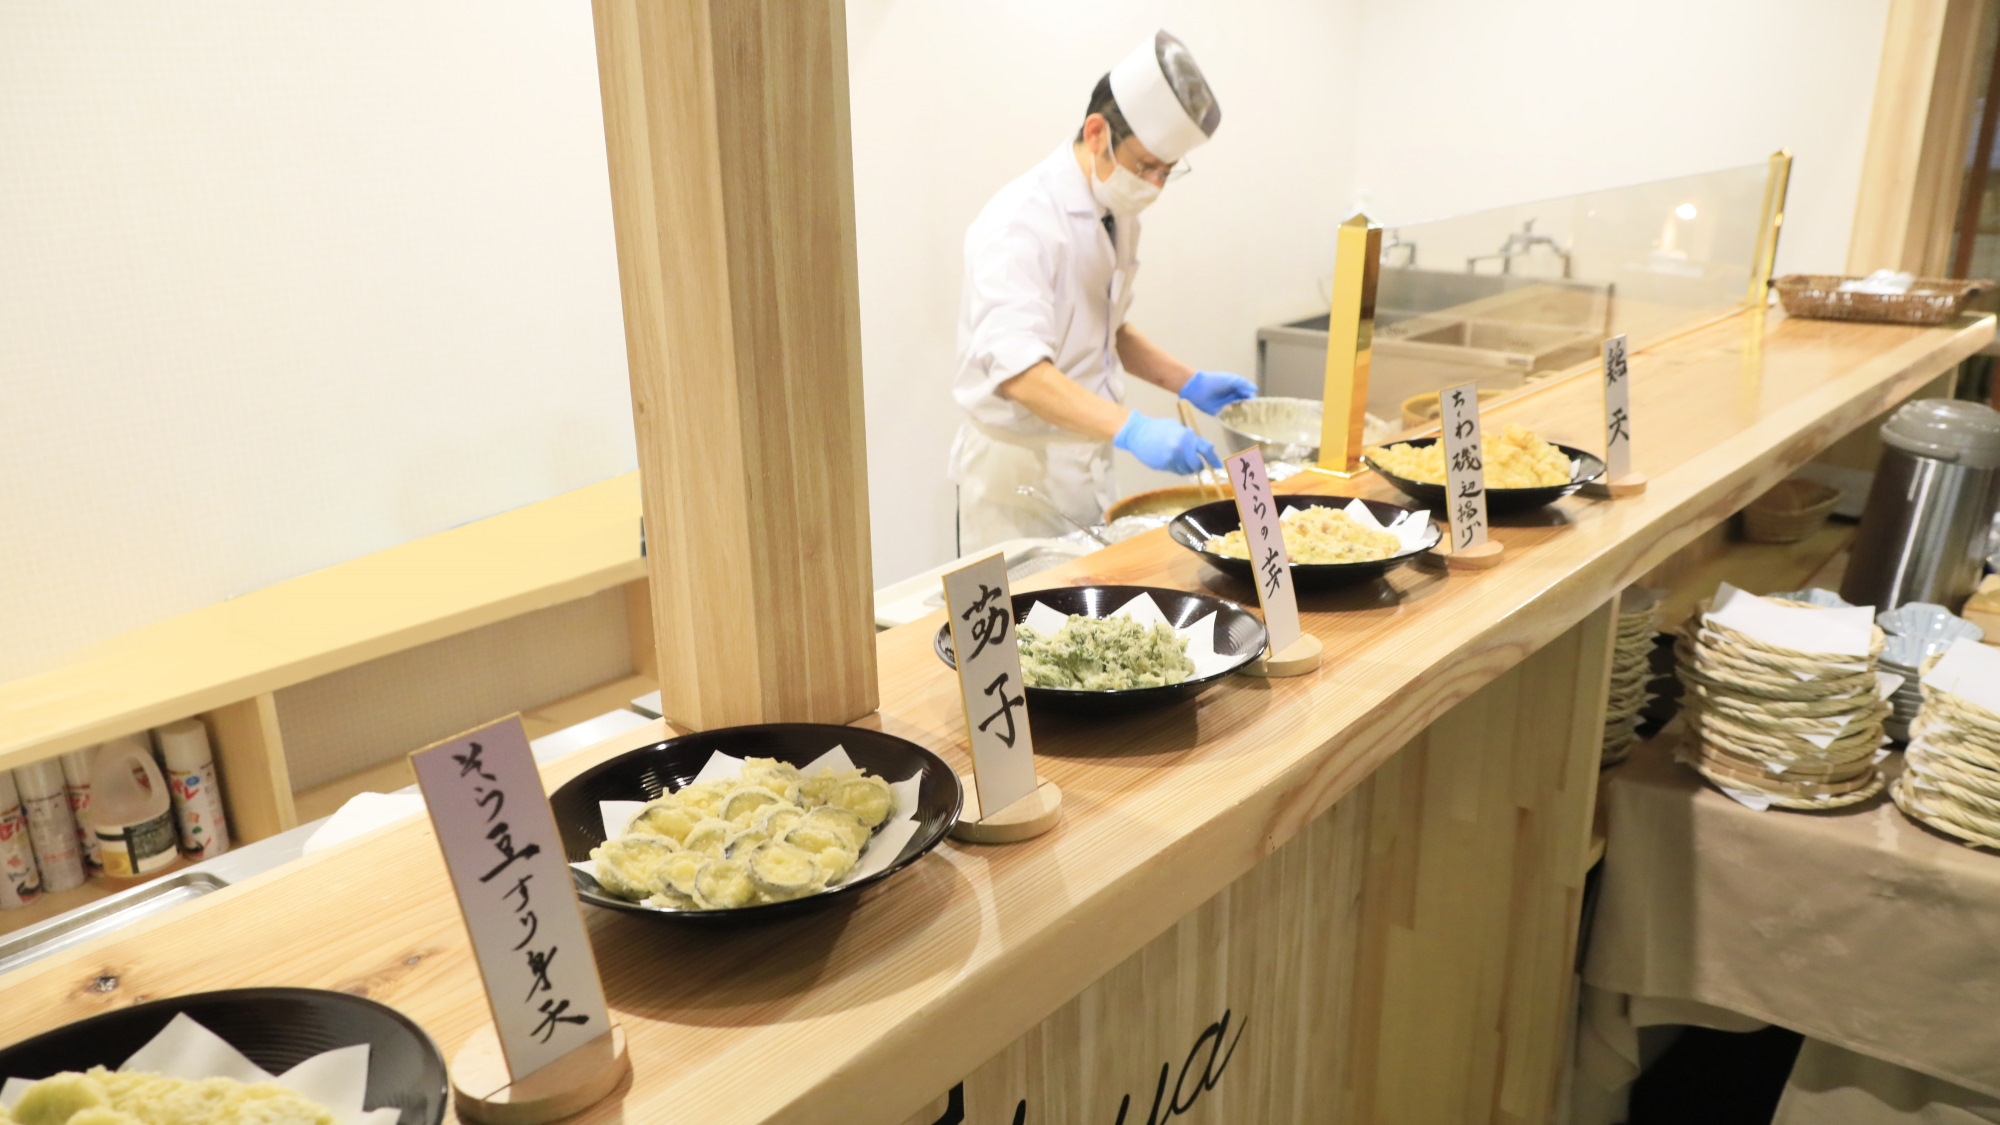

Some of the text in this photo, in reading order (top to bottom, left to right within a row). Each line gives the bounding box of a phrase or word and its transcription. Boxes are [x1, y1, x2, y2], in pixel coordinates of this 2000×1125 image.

[1240, 457, 1282, 599] たらの芽
[452, 742, 590, 1044] そら豆すり身天
